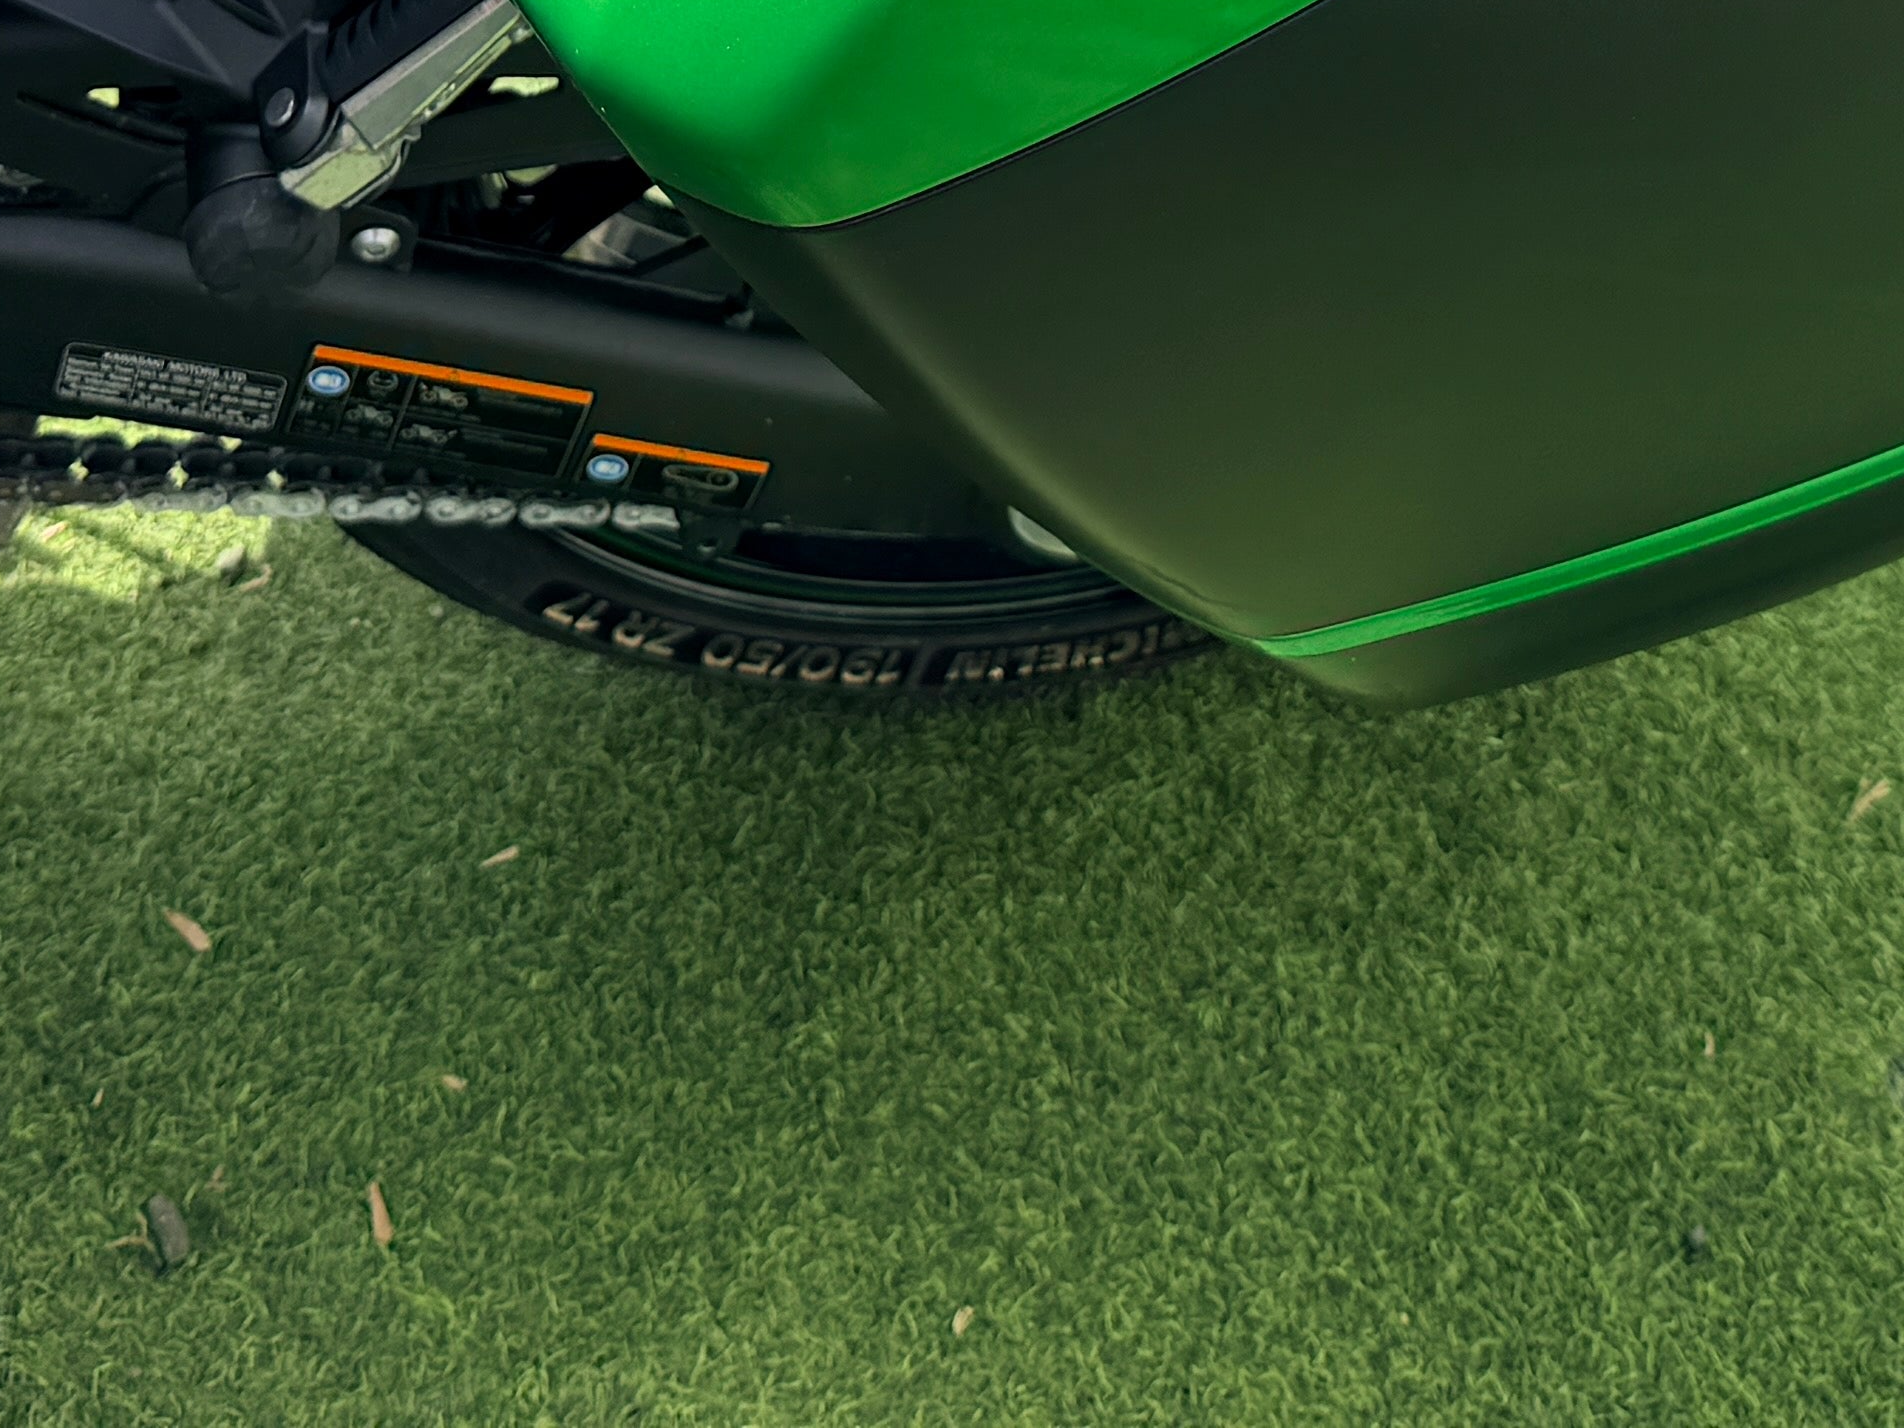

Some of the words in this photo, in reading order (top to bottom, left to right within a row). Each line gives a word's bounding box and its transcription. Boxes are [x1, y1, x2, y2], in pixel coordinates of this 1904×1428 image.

[542, 593, 609, 633] 17
[612, 610, 696, 658] ZR
[701, 632, 901, 686] 190/50
